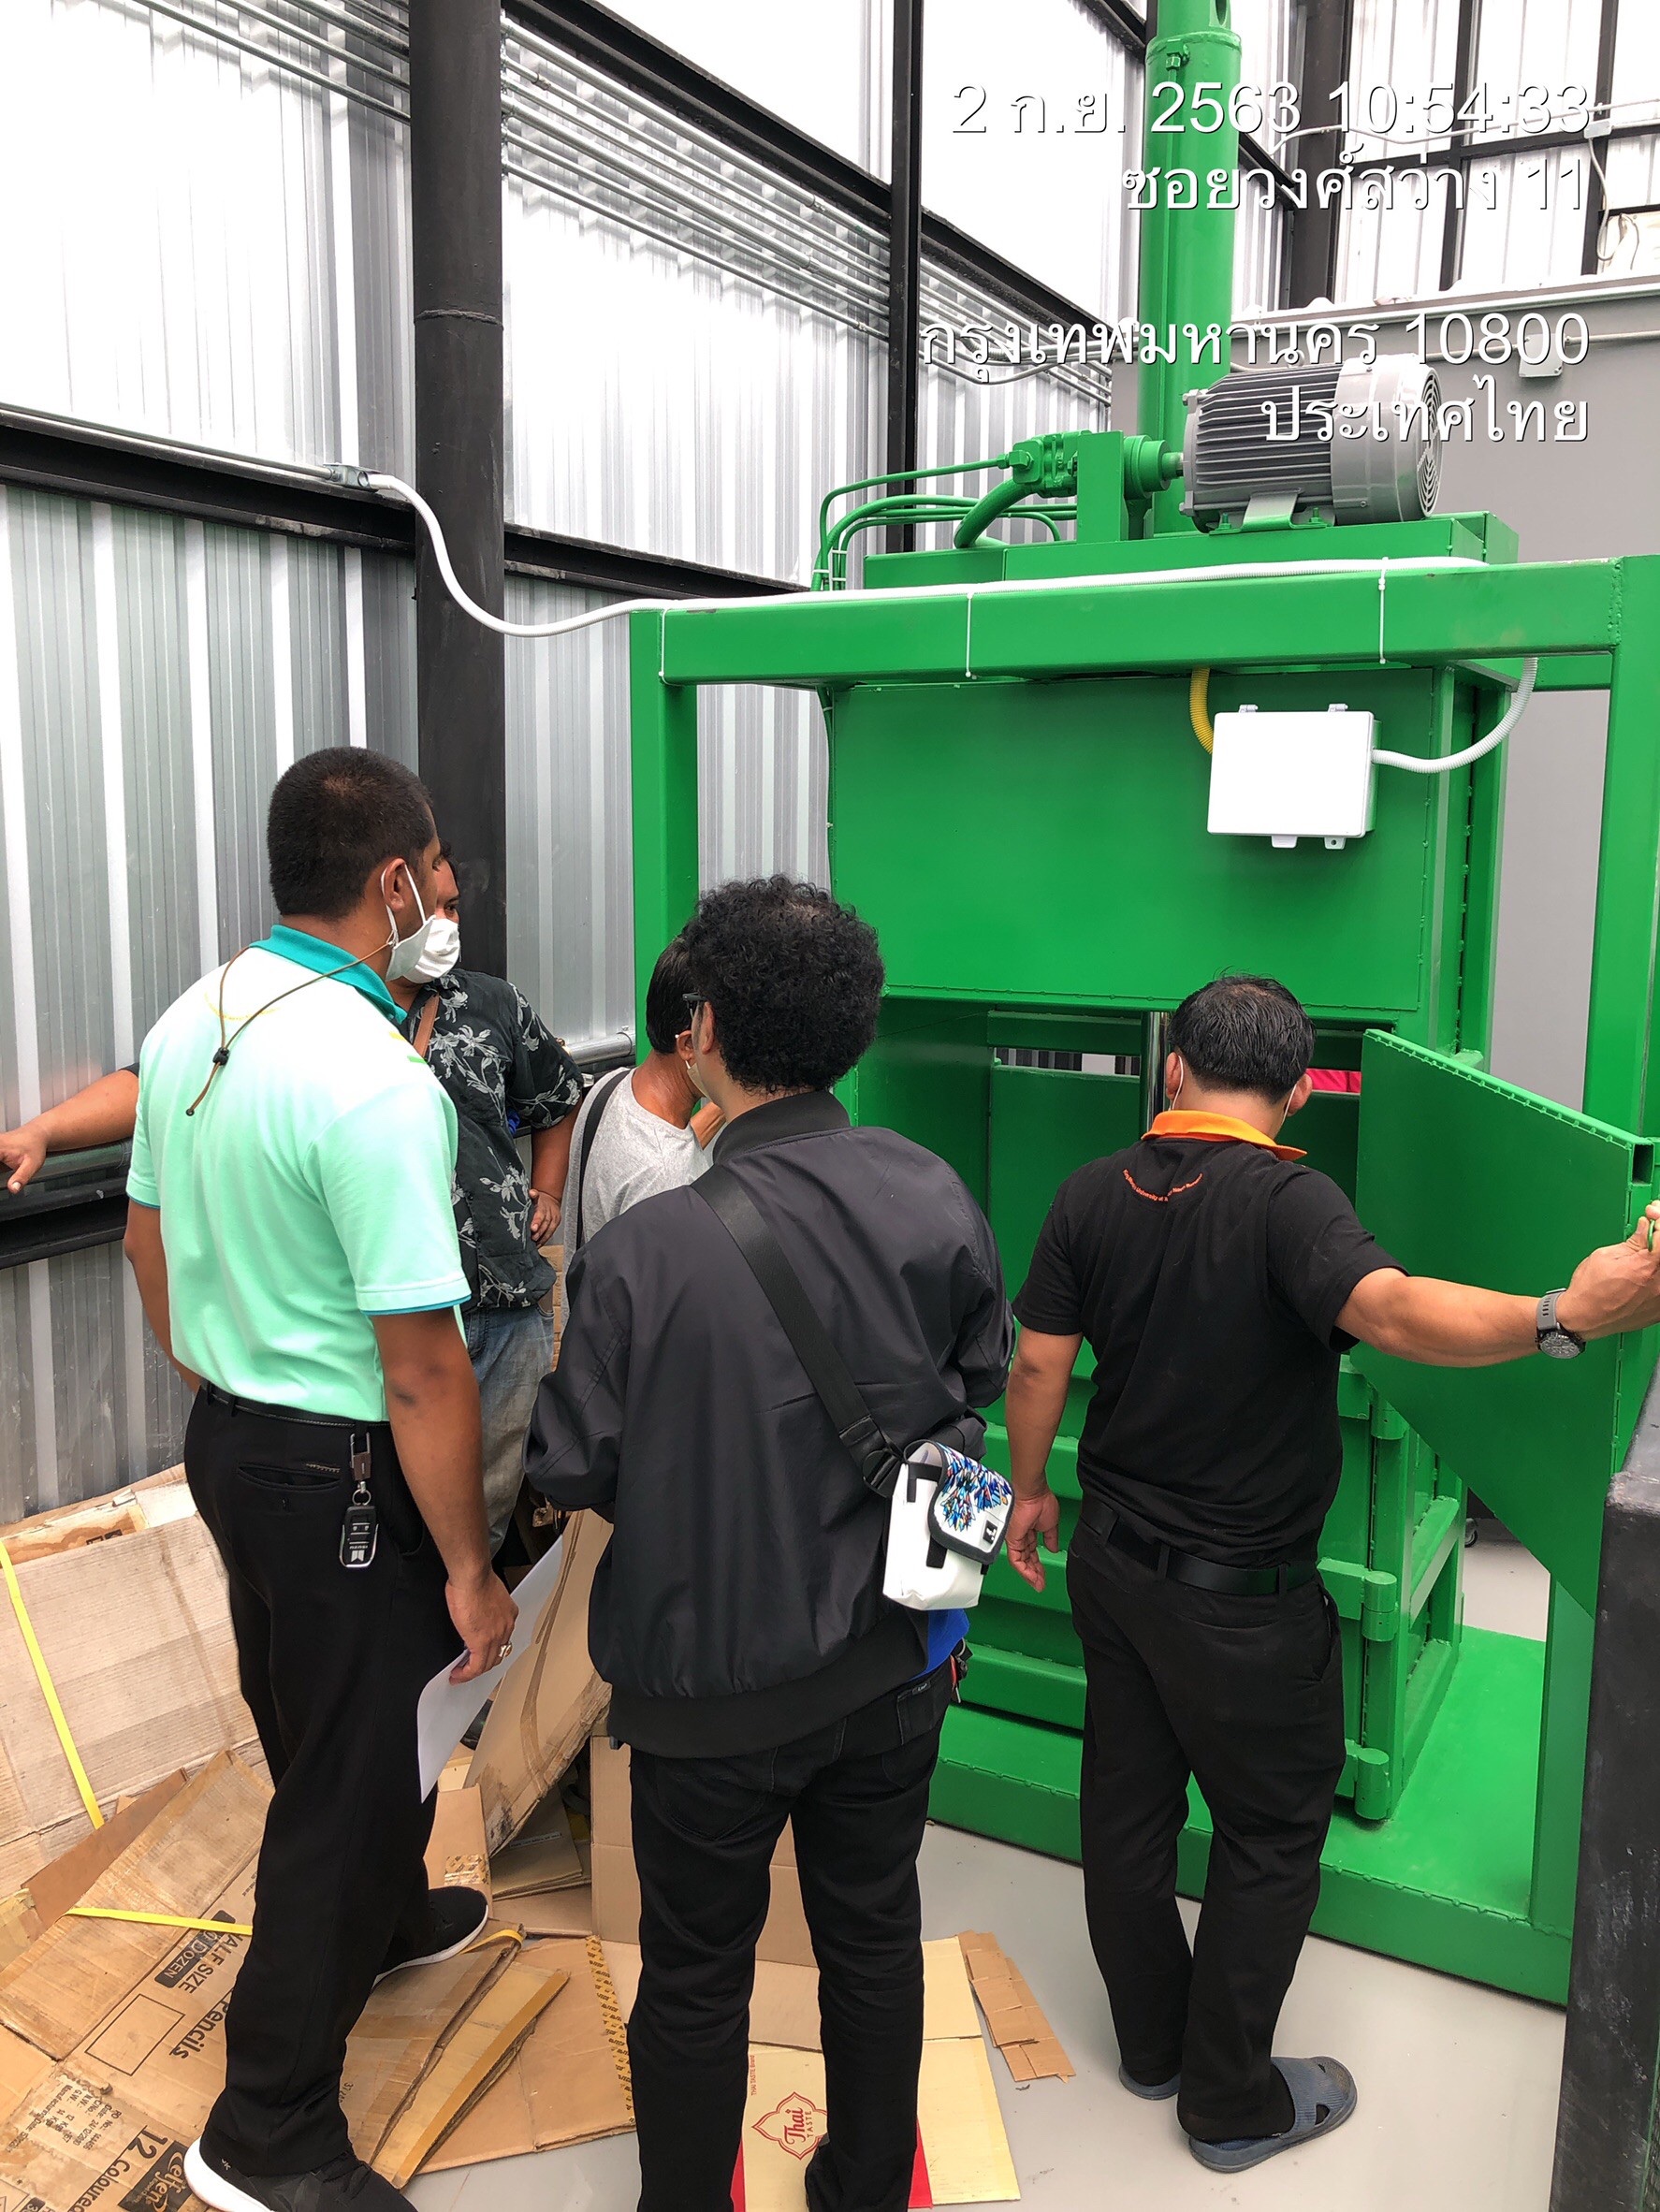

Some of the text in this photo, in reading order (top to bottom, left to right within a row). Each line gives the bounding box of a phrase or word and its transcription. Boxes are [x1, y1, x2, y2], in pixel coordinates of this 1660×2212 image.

[178, 1964, 214, 1994] SIZE
[784, 2107, 807, 2145] Thai
[805, 2110, 814, 2138] TASTE
[128, 2130, 168, 2159] 12
